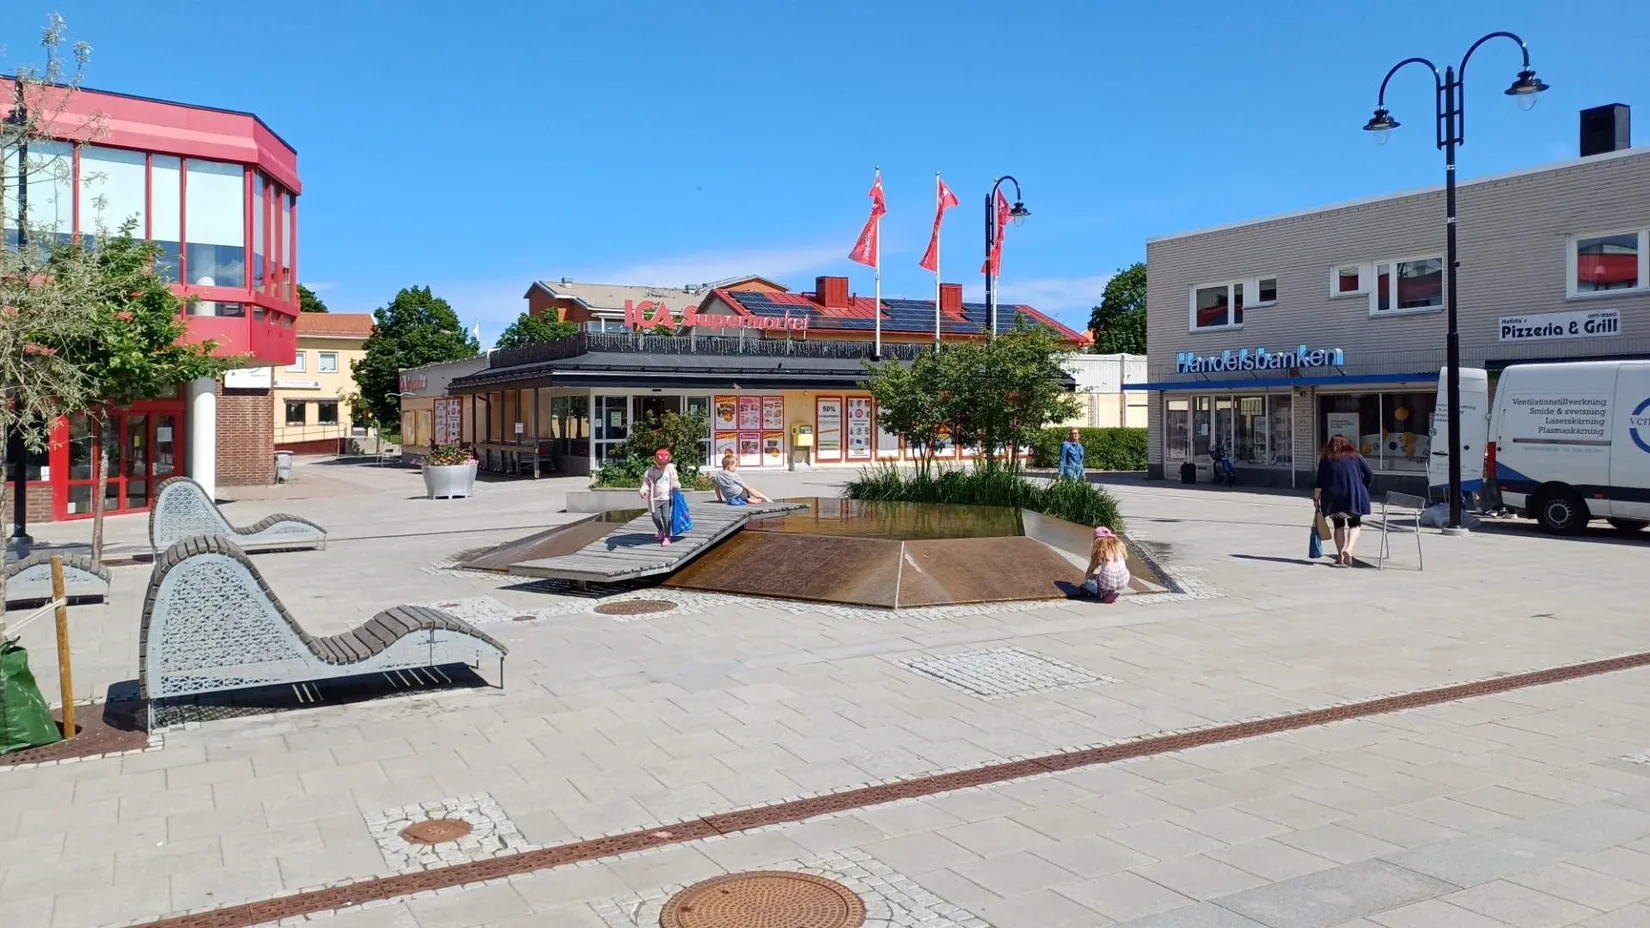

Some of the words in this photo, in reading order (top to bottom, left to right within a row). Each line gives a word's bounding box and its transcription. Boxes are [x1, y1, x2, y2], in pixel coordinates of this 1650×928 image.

[625, 299, 676, 329] ICA
[682, 305, 810, 331] Supermarket
[1501, 323, 1563, 339] Pizzeria
[1568, 321, 1579, 335] &
[1584, 318, 1618, 334] Grill
[1176, 345, 1343, 373] Handelsbanken
[1512, 398, 1607, 407] Ventilationstillverkning
[822, 405, 836, 413] 50%
[1529, 407, 1554, 415] Smide
[1564, 408, 1606, 417] svetsning
[1545, 417, 1605, 426] Laserskärning
[1538, 426, 1604, 436] Plasmaskärning
